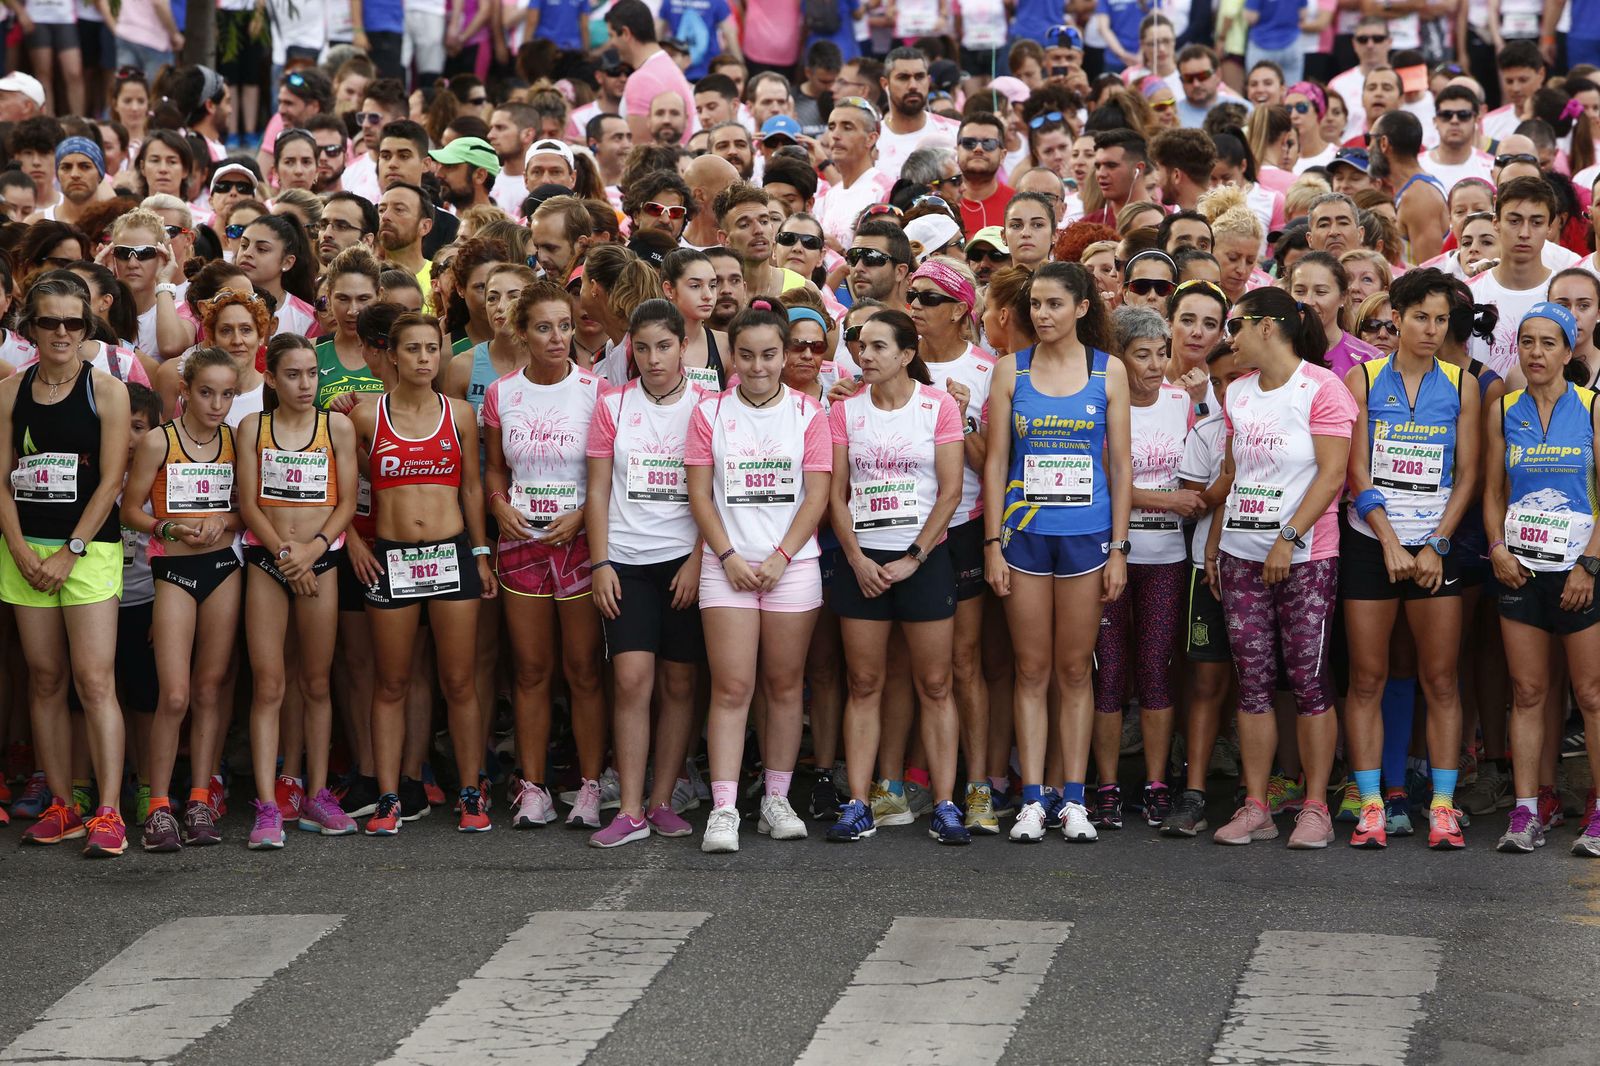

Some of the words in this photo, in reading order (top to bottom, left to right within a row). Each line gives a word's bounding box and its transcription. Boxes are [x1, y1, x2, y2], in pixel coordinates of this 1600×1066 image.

[688, 372, 717, 381] VIRAN
[321, 384, 356, 393] PUENTE
[1032, 415, 1095, 432] olimpo
[1394, 421, 1447, 436] olimpo
[509, 429, 524, 442] Por
[530, 430, 538, 440] ti
[1387, 446, 1441, 458] COVIRAN
[1526, 443, 1581, 457] olimpo
[27, 458, 76, 467] COVIRAN
[275, 456, 326, 465] COVIRAN
[380, 456, 455, 476] Polisalud
[642, 459, 684, 468] COVIRA
[856, 457, 871, 470] Por
[1392, 459, 1423, 475] 7203
[35, 469, 48, 483] 14
[286, 469, 302, 483] 20
[648, 471, 678, 486] 8313
[745, 473, 775, 487] 8312
[1055, 472, 1063, 486] 2
[196, 480, 209, 493] 19
[525, 487, 575, 495] COVIRAN
[864, 483, 914, 495] COVIRAN
[530, 499, 558, 513] 9125
[870, 496, 898, 512] 8758
[1239, 499, 1264, 514] 7034
[1518, 514, 1569, 528] COVIRAN
[1520, 527, 1548, 544] 8374
[402, 549, 455, 561] COVIRAN
[410, 564, 438, 579] 7812
